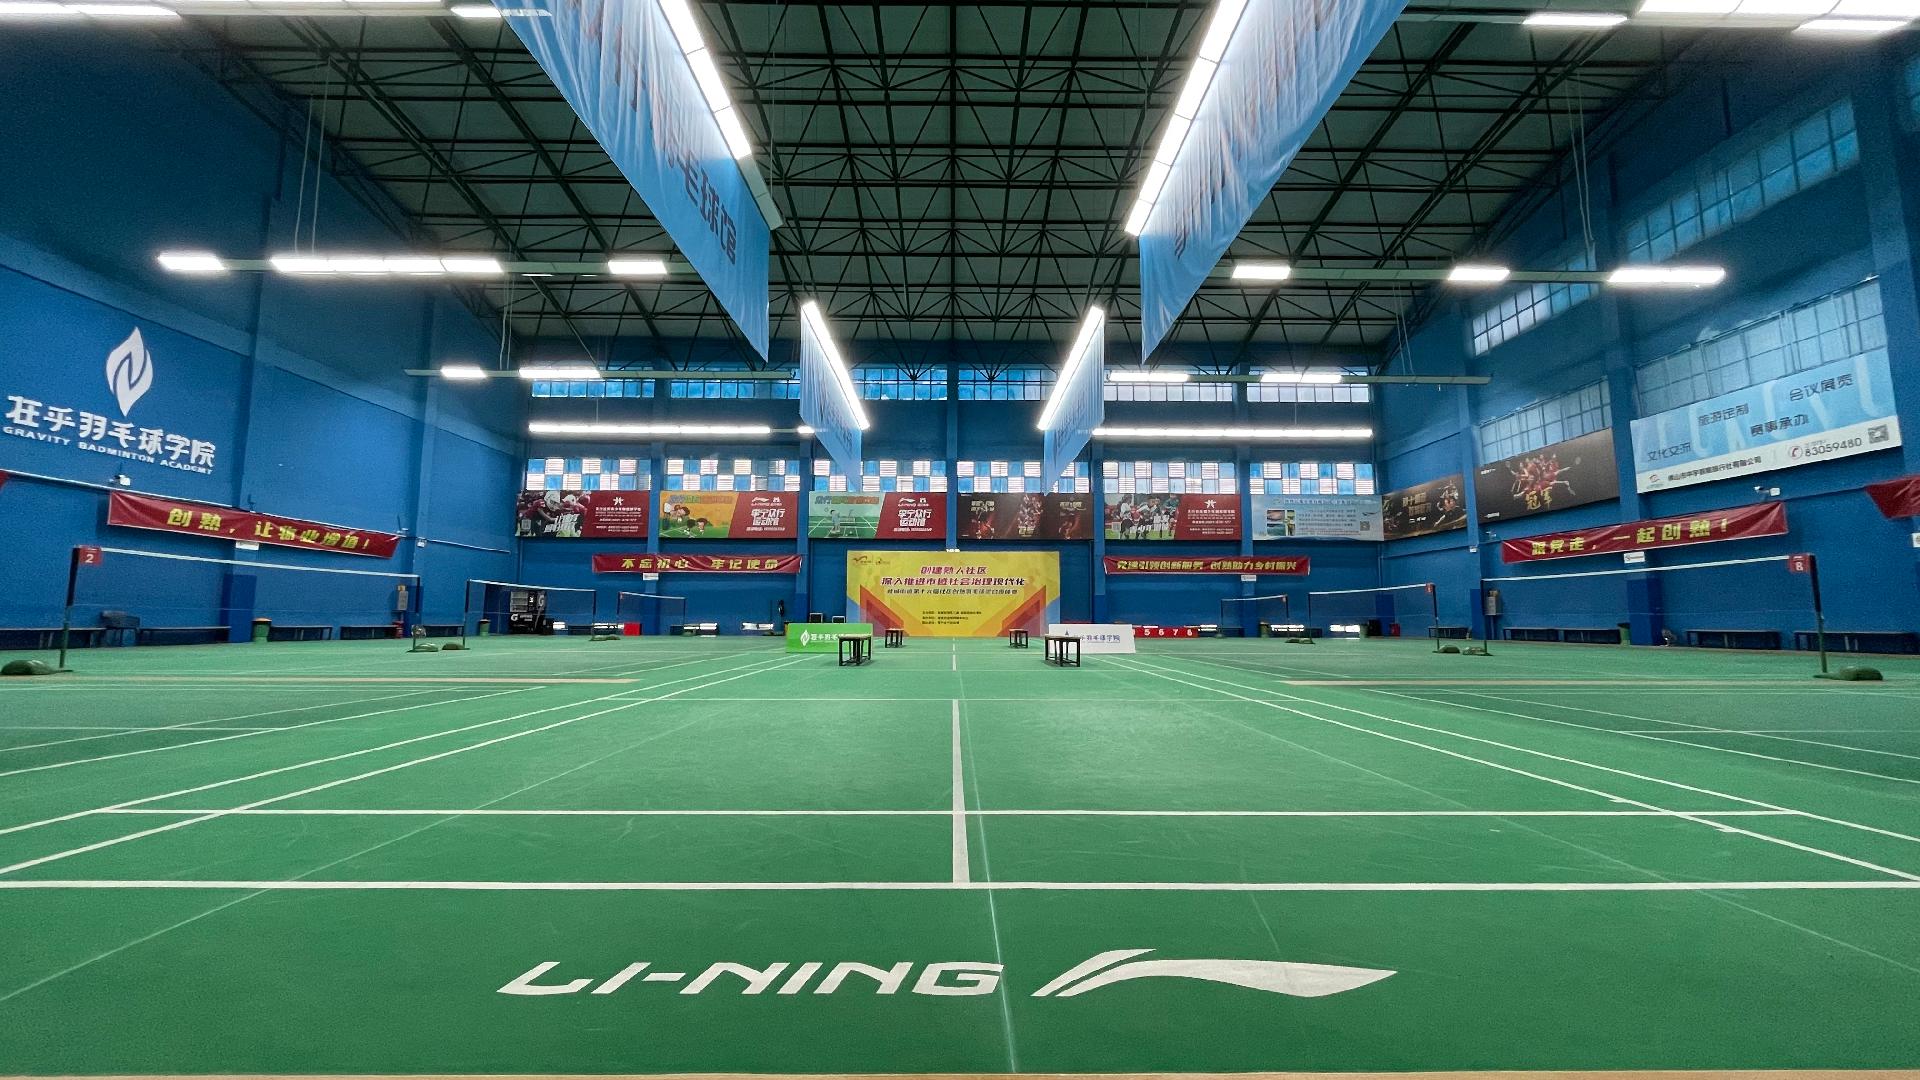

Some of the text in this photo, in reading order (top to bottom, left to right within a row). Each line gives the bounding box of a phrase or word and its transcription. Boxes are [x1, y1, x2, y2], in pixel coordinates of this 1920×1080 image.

[1789, 373, 1853, 401] 会议展览
[1697, 402, 1749, 427] 旅游定制
[1750, 413, 1809, 437] 赛事承办
[5, 395, 216, 468] 在乎羽毛球学院
[3, 426, 213, 475] GRAVITY BADMINTON ACADEMY
[1646, 441, 1692, 462] 文化交流
[1804, 437, 1863, 458] 83059480
[1525, 486, 1553, 510] 冠军
[85, 553, 95, 564] 2
[621, 558, 780, 570] 不忘初心 牢记使命
[881, 577, 1025, 586] 深入推进市域社会治理现代化
[920, 566, 987, 575] 创建熟人社区
[1144, 628, 1151, 636] 5
[1173, 628, 1179, 636] 7
[496, 961, 1004, 996] LI-NING
